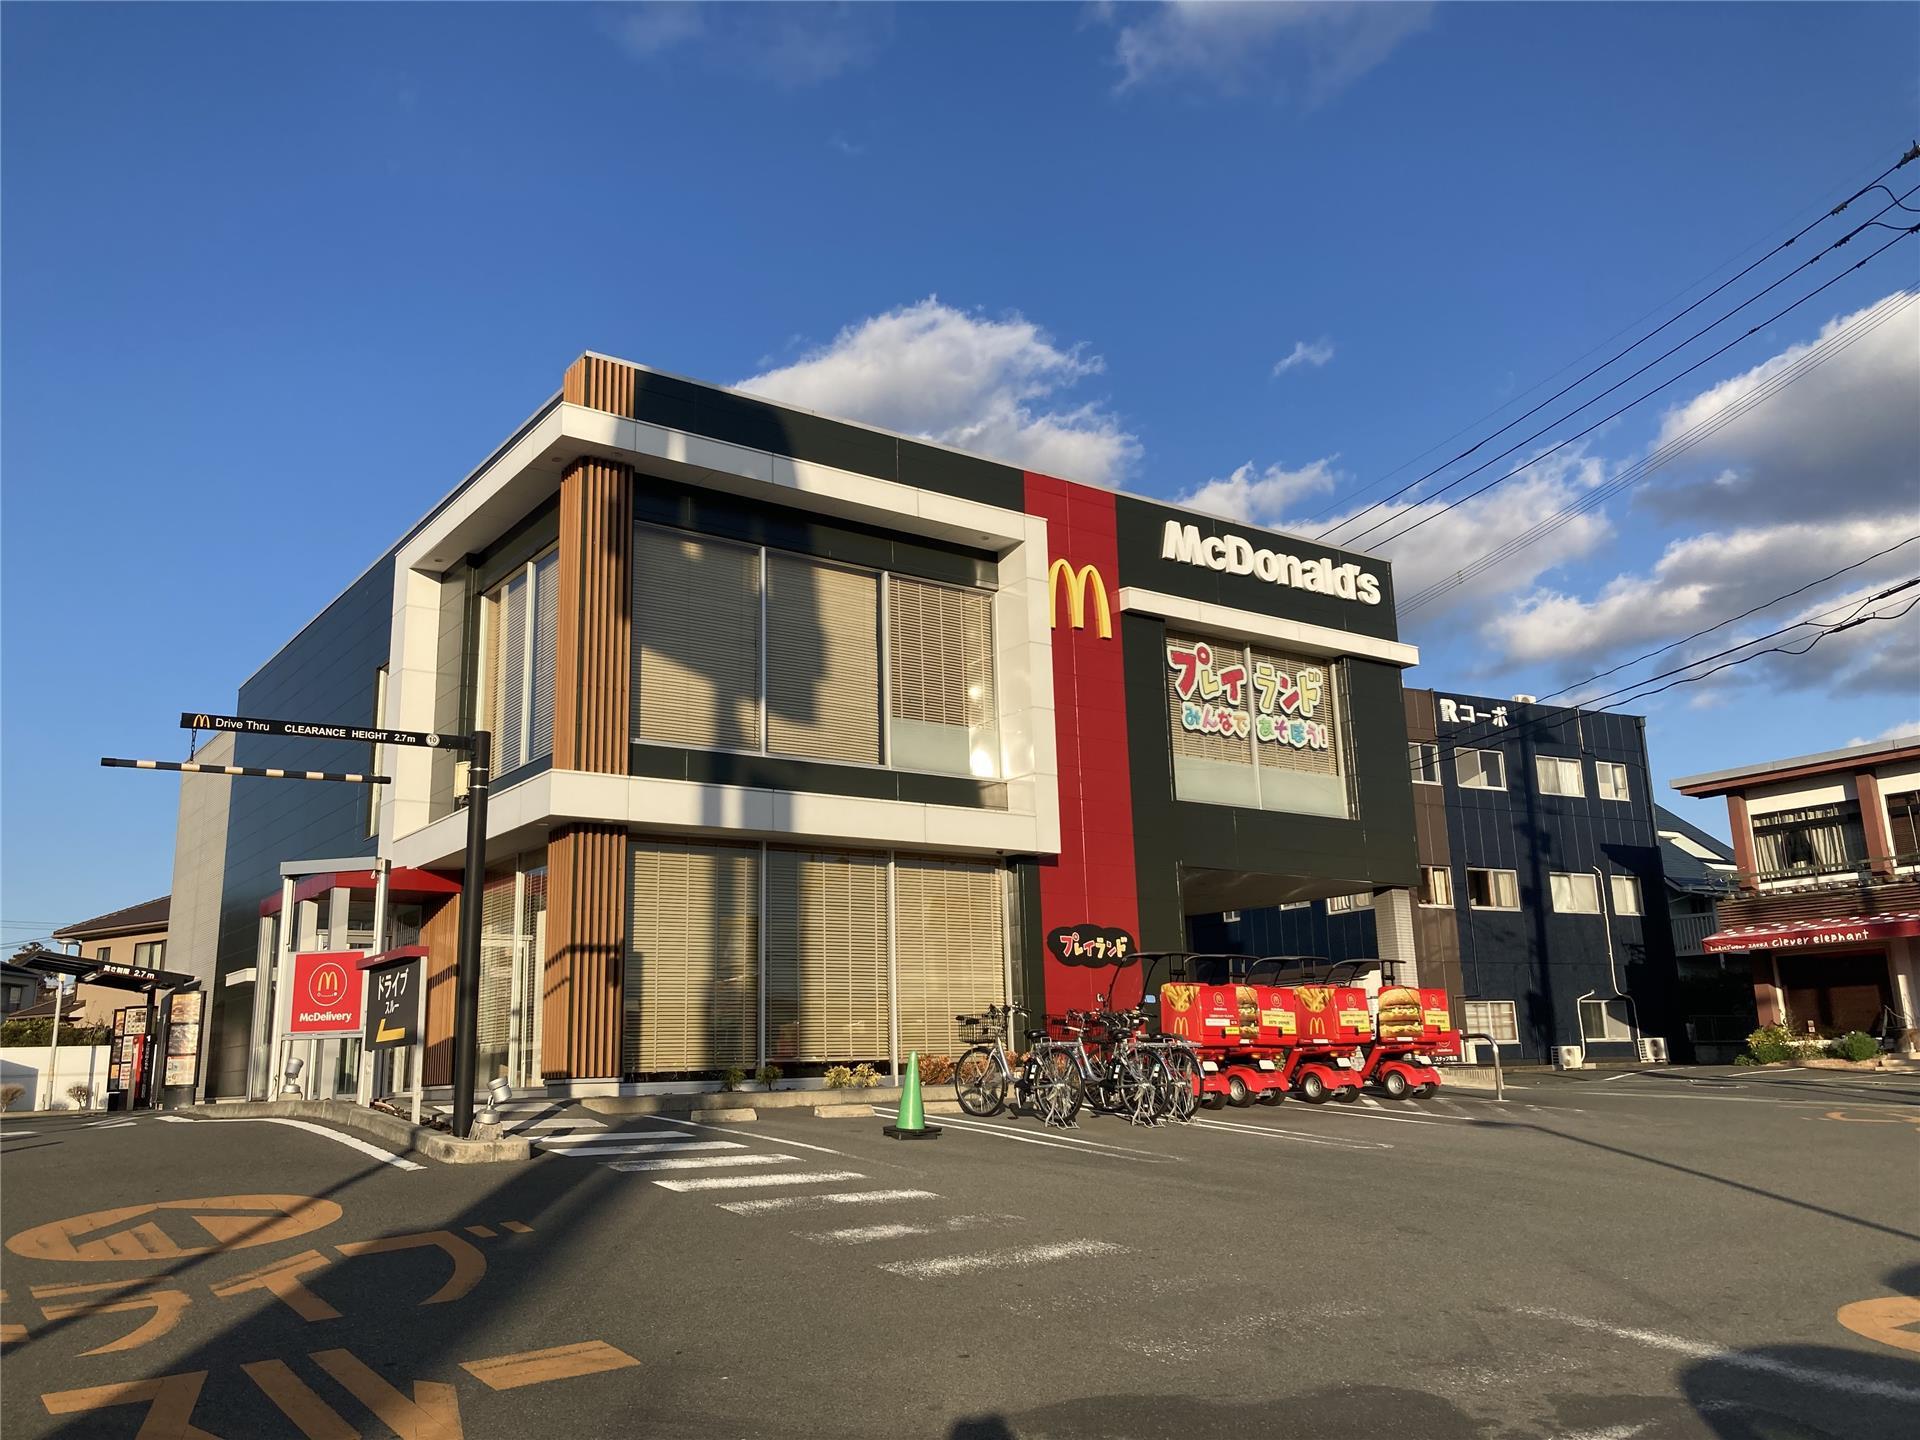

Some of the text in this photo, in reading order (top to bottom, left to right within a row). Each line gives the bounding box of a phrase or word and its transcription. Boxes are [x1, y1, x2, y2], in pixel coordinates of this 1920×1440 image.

[1161, 519, 1382, 606] McDonald's
[215, 718, 243, 729] Drive
[246, 720, 270, 731] Thru
[284, 724, 347, 738] CLEARANCE
[351, 730, 388, 741] HEIGHT
[428, 736, 437, 744] 10
[1060, 932, 1128, 959] プレイランド
[1813, 929, 1869, 944] elephant
[299, 1011, 352, 1023] McDelivery
